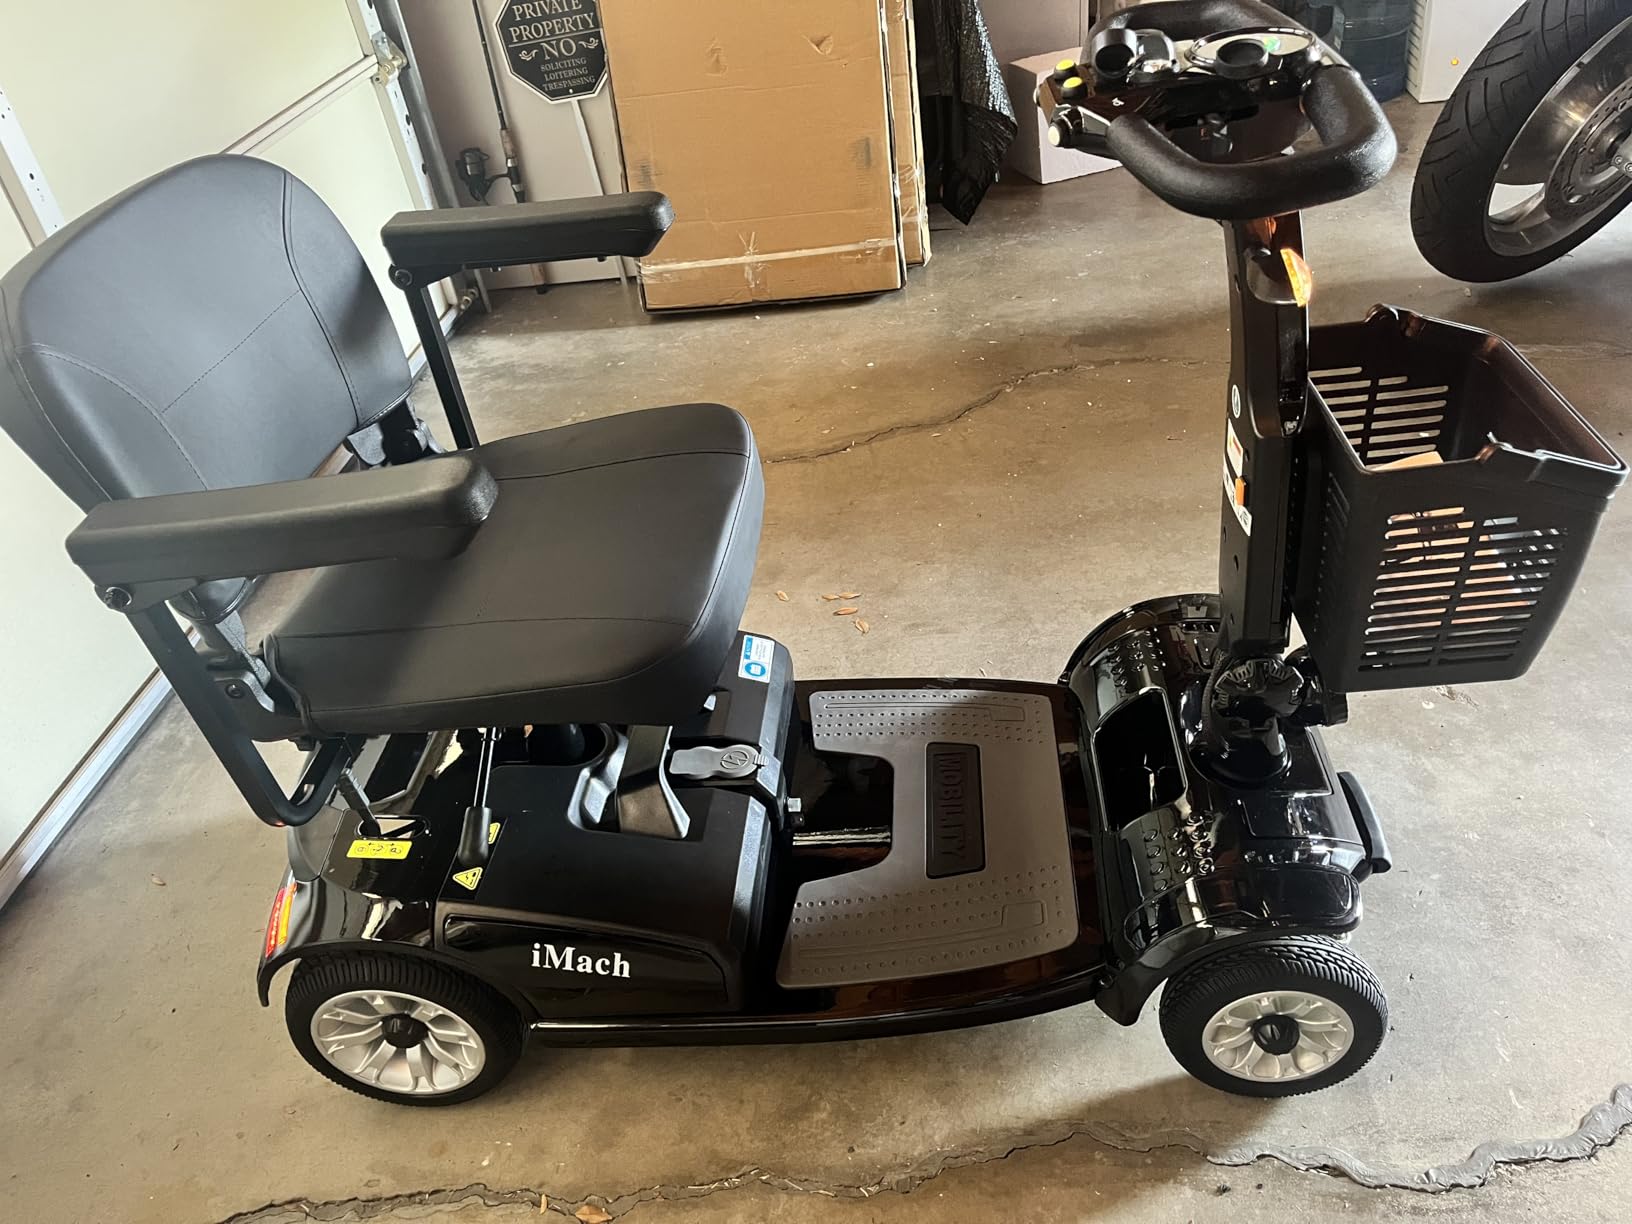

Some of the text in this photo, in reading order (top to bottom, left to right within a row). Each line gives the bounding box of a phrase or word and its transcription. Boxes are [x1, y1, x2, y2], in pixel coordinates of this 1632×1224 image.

[512, 0, 582, 21] PRIVATE
[508, 12, 594, 42] PROPERTY
[540, 38, 576, 60] NO
[541, 57, 587, 72] SOLICITING
[544, 67, 588, 81] LOITERING
[542, 76, 595, 91] TRESPASSING
[934, 751, 966, 859] MOBILITY
[531, 942, 630, 978] iMach
